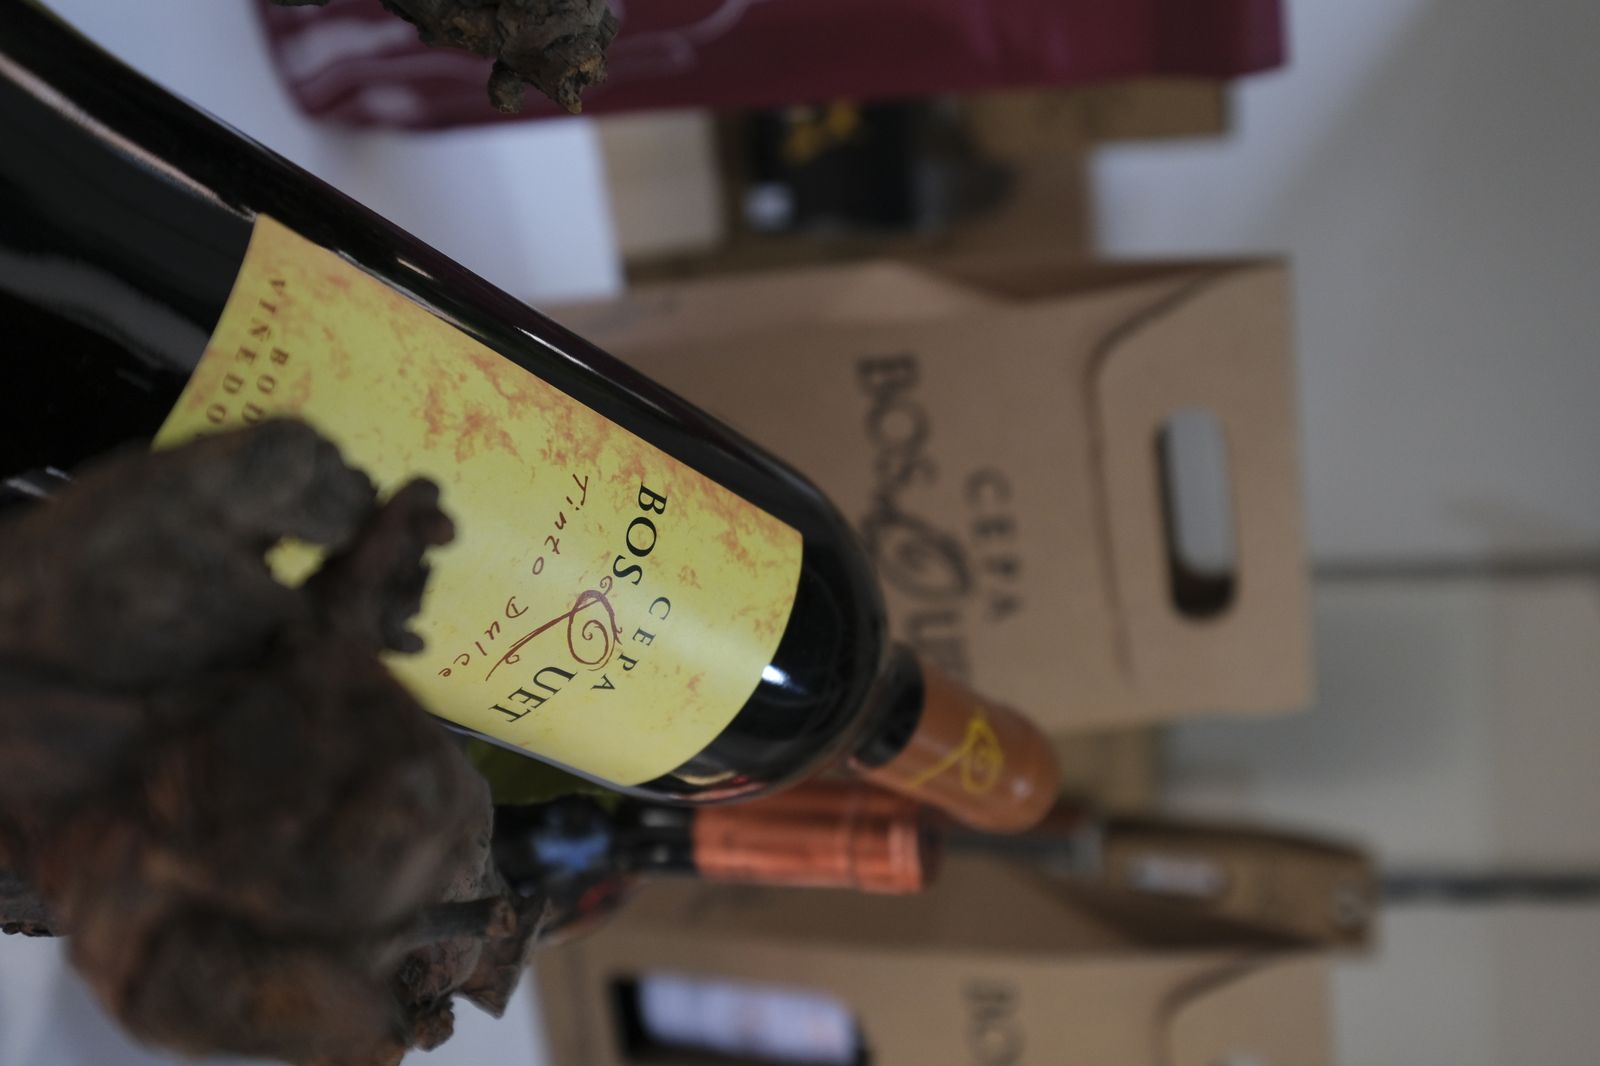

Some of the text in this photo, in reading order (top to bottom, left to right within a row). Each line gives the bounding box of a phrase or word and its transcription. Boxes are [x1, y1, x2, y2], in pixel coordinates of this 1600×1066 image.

[205, 279, 287, 426] VIÑEDO
[241, 347, 290, 425] BOD
[437, 473, 589, 678] Tinto Dulce
[485, 481, 668, 723] BOSQUET
[590, 596, 671, 692] CEPA
